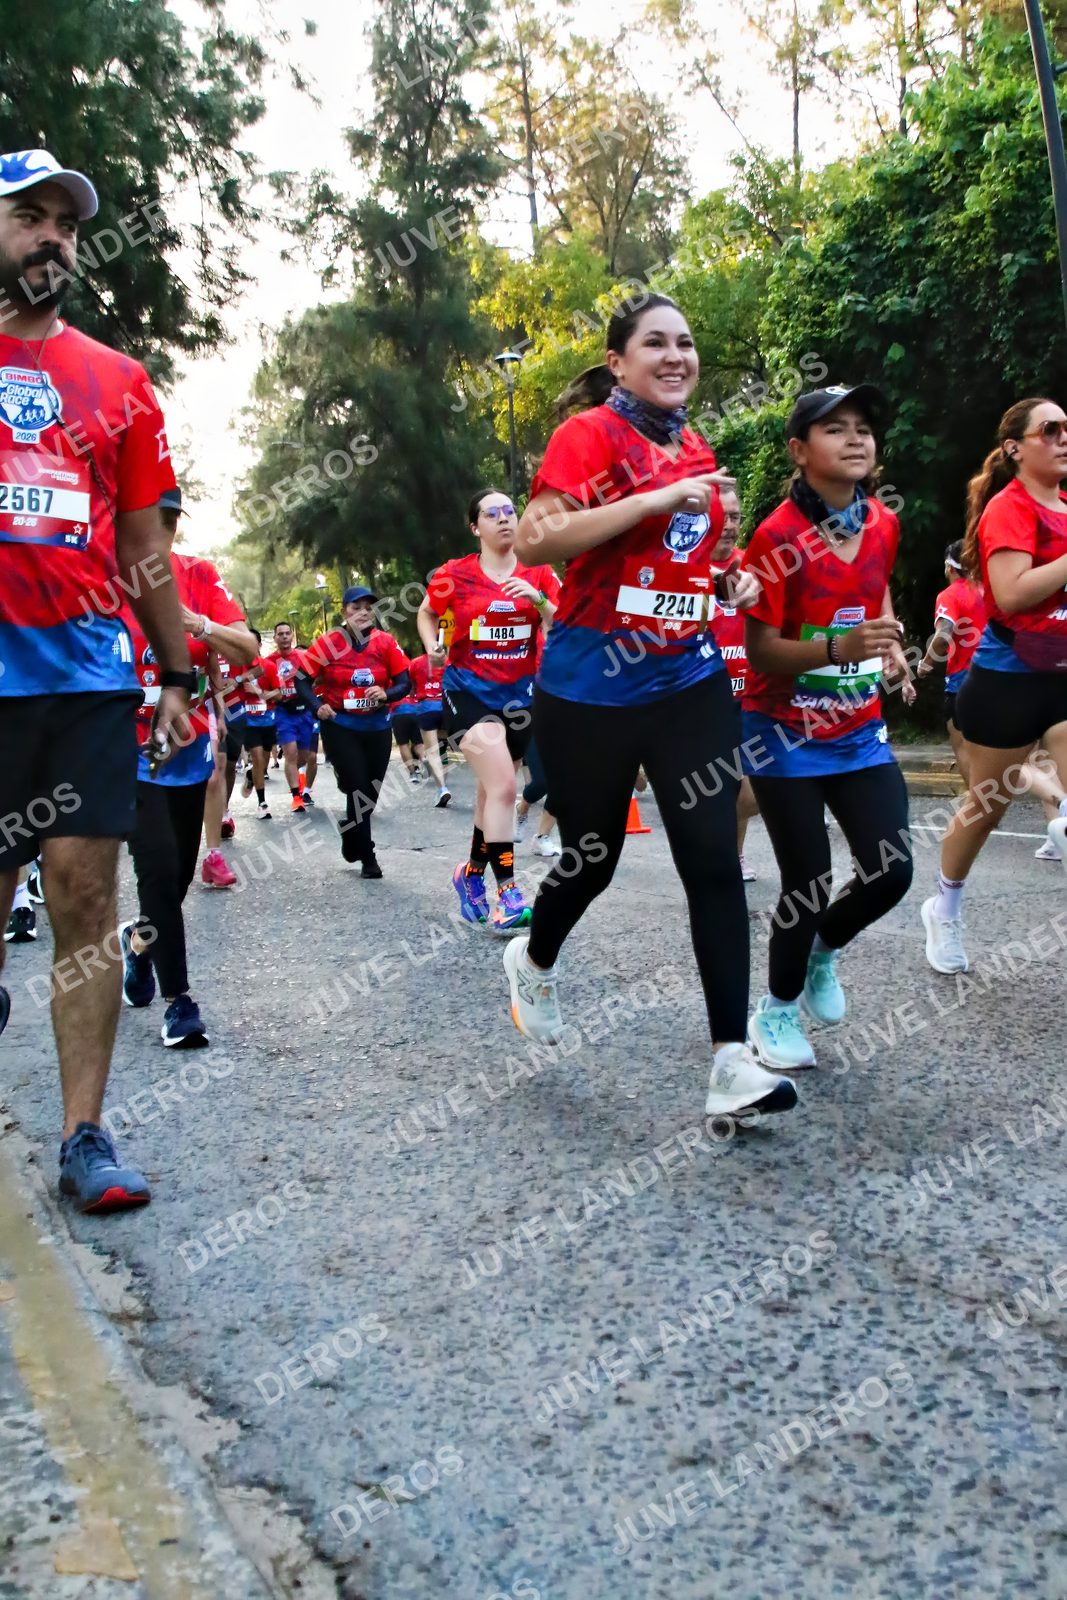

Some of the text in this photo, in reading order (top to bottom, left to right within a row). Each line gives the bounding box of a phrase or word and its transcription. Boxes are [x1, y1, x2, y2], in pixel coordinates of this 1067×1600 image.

[7, 385, 43, 399] Global
[15, 432, 37, 442] 2026
[653, 593, 694, 618] 2244
[490, 627, 515, 640] 1484
